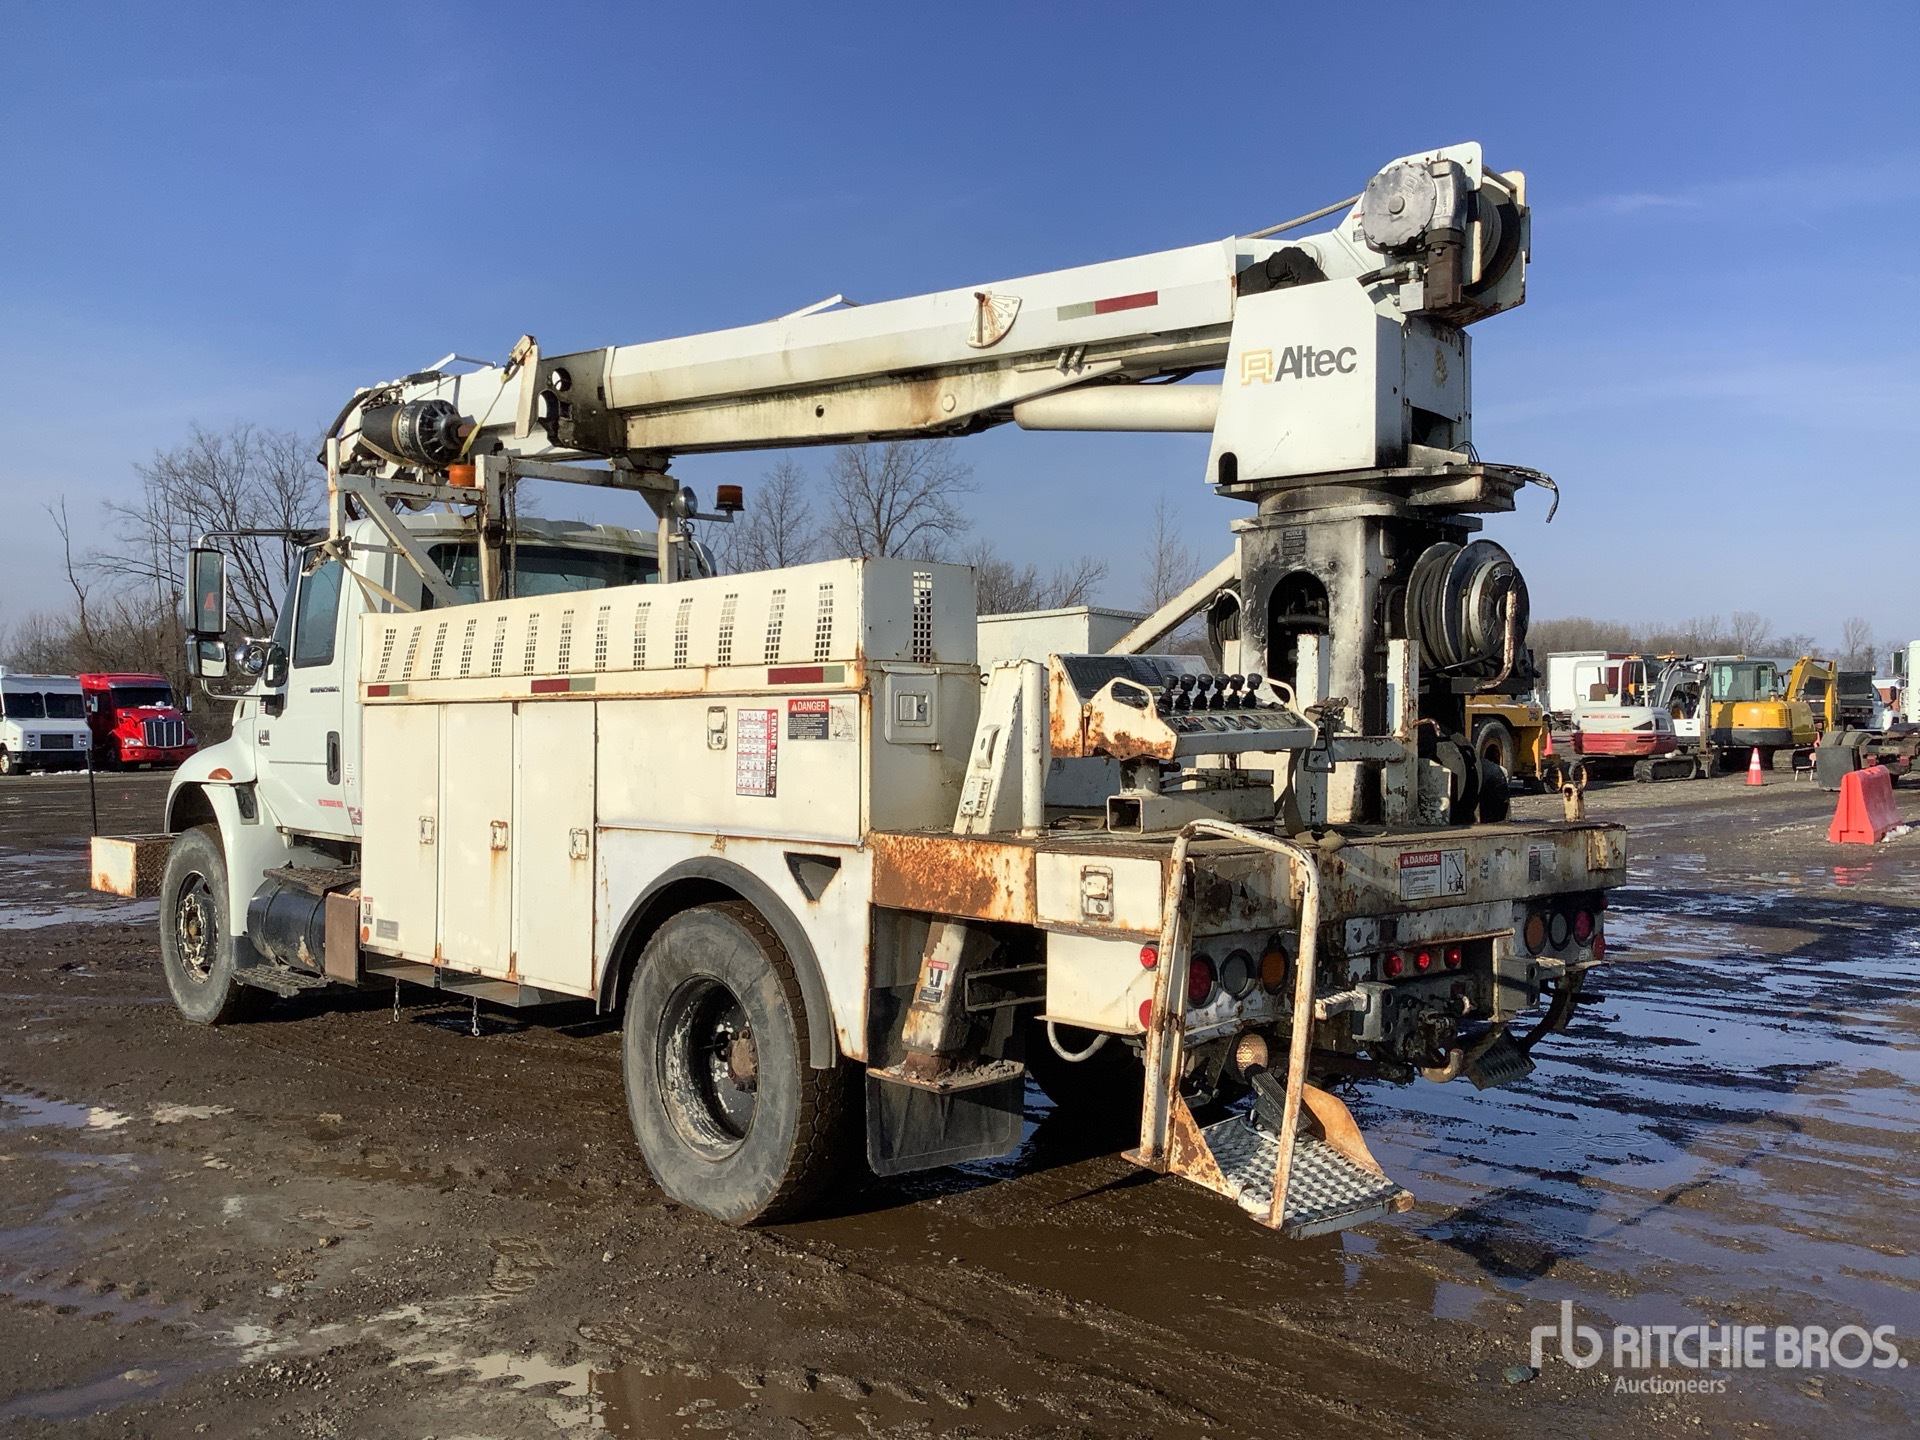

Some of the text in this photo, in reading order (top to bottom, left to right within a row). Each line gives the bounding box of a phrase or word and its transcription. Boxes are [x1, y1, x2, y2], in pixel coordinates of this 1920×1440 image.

[1275, 345, 1357, 382] Altec
[797, 701, 826, 711] DANGER
[1409, 853, 1438, 864] DANGER
